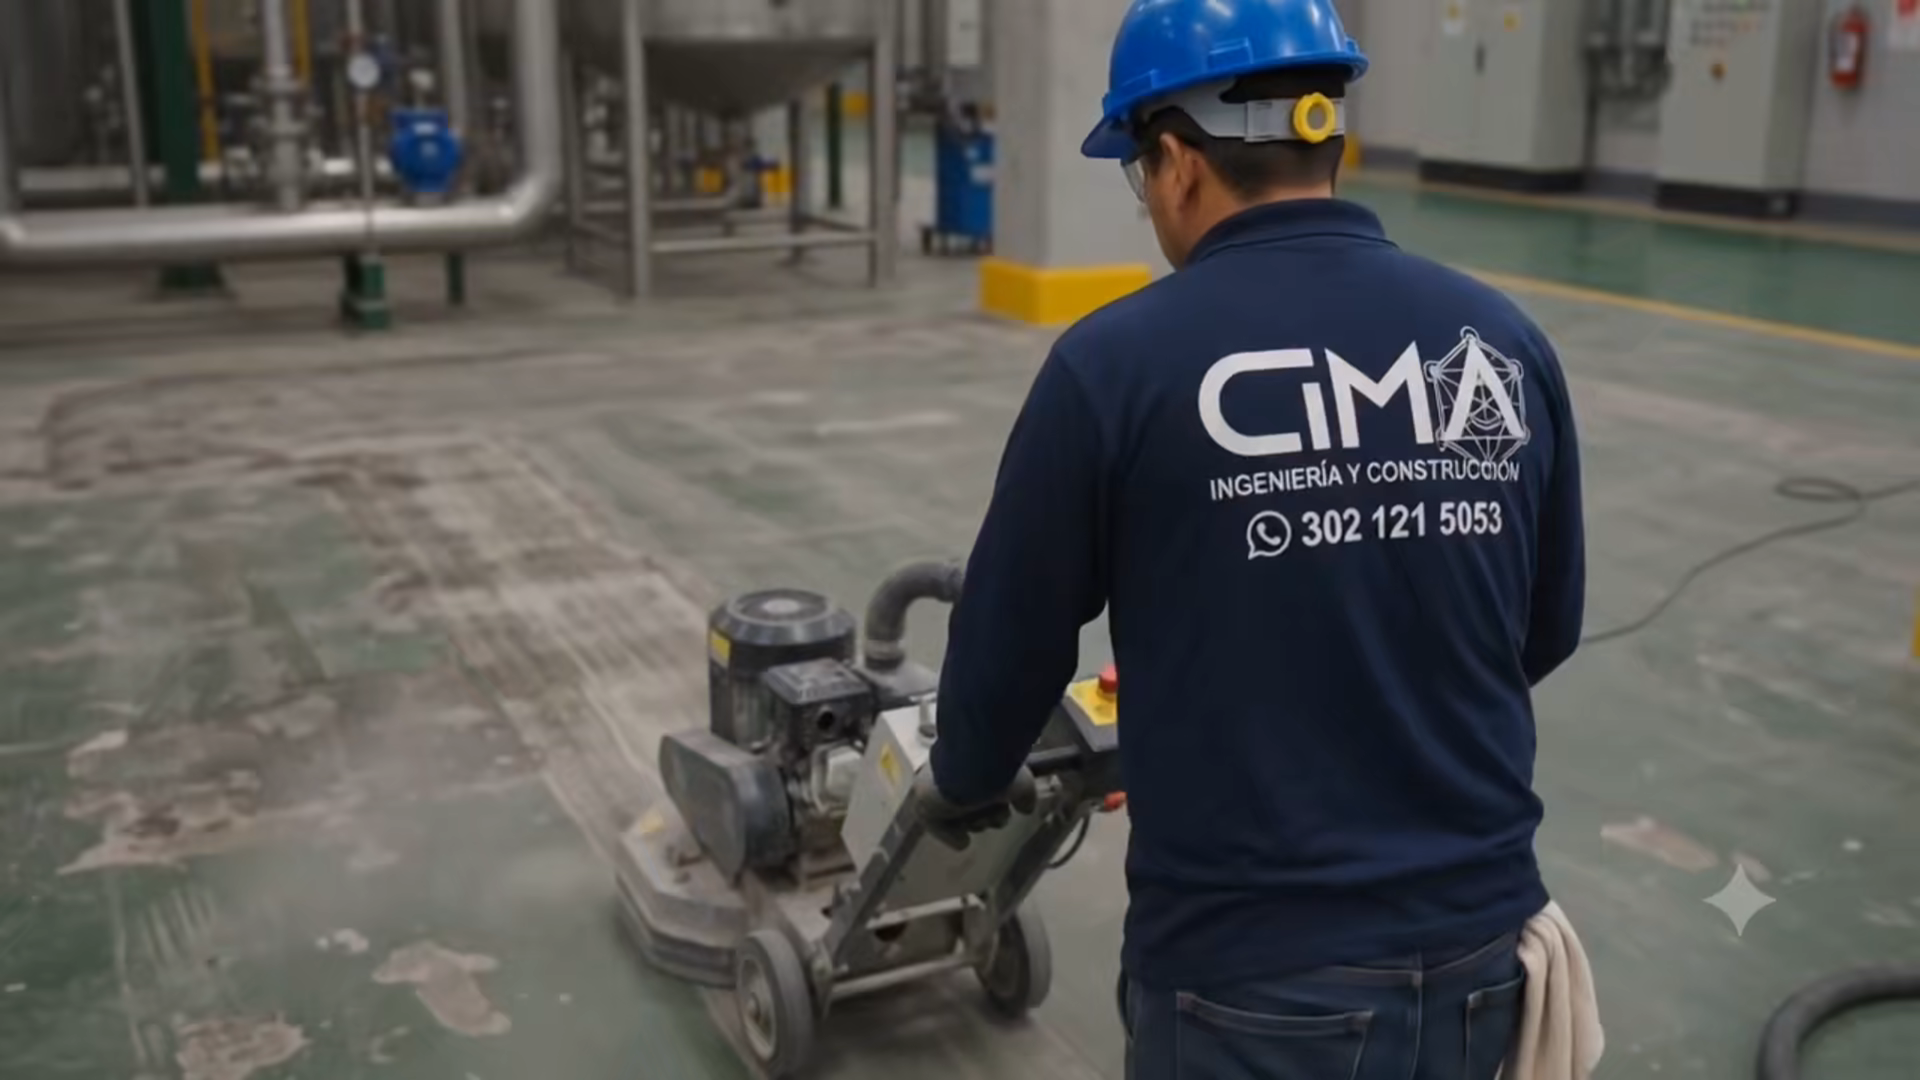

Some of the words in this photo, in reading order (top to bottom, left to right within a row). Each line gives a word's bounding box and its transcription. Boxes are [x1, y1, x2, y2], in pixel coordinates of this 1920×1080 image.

[1210, 459, 1344, 500] INGENIERÍA
[1347, 463, 1361, 484] Y
[1301, 507, 1363, 547] 302
[1371, 502, 1426, 539] 121
[1440, 500, 1503, 535] 5053
